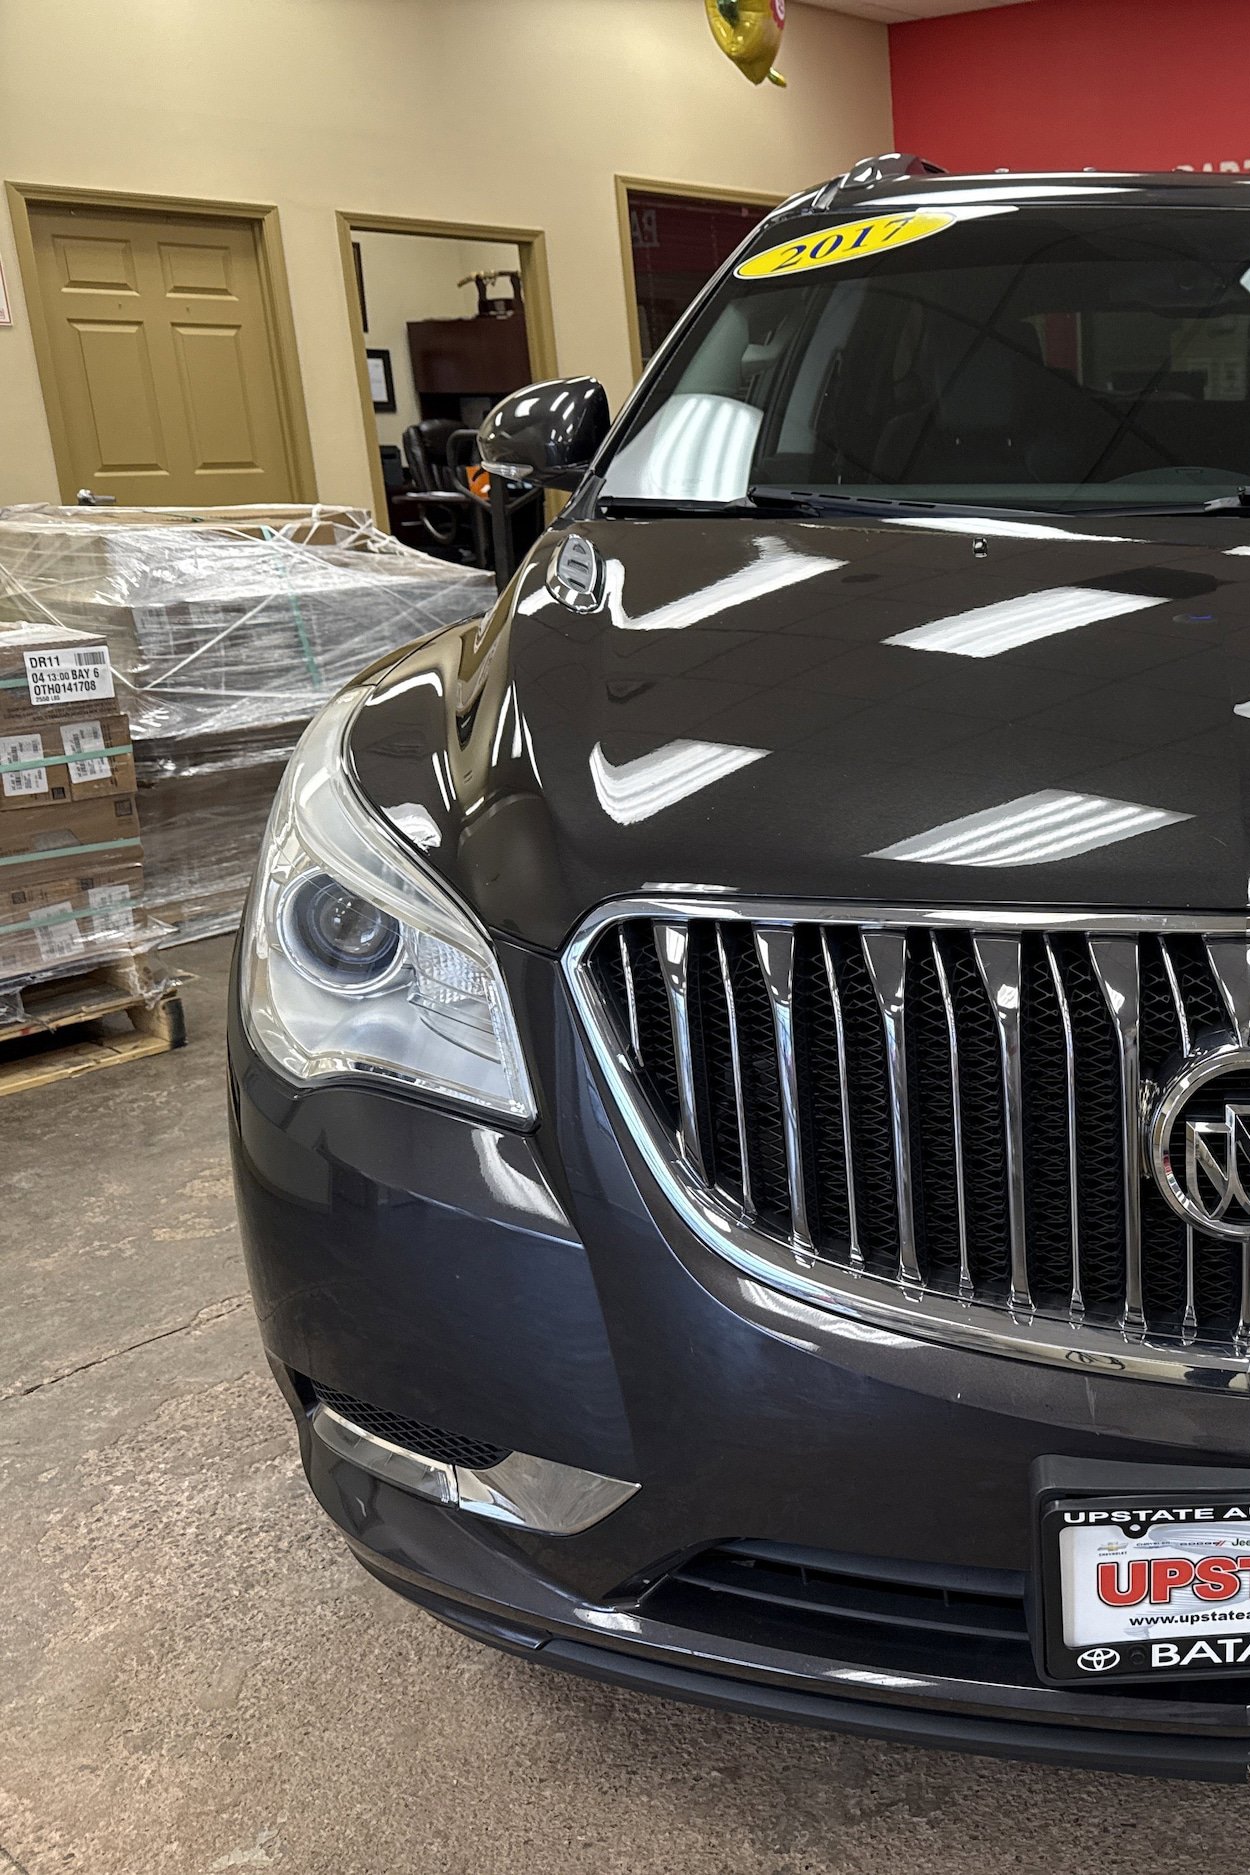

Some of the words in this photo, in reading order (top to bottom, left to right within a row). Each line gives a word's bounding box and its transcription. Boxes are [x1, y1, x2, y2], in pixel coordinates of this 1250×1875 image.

[771, 215, 915, 272] 2017
[29, 655, 61, 669] DR11
[31, 672, 45, 684] 04
[71, 668, 91, 681] BAY
[93, 667, 100, 679] 6
[1064, 1508, 1215, 1524] UPSTATE
